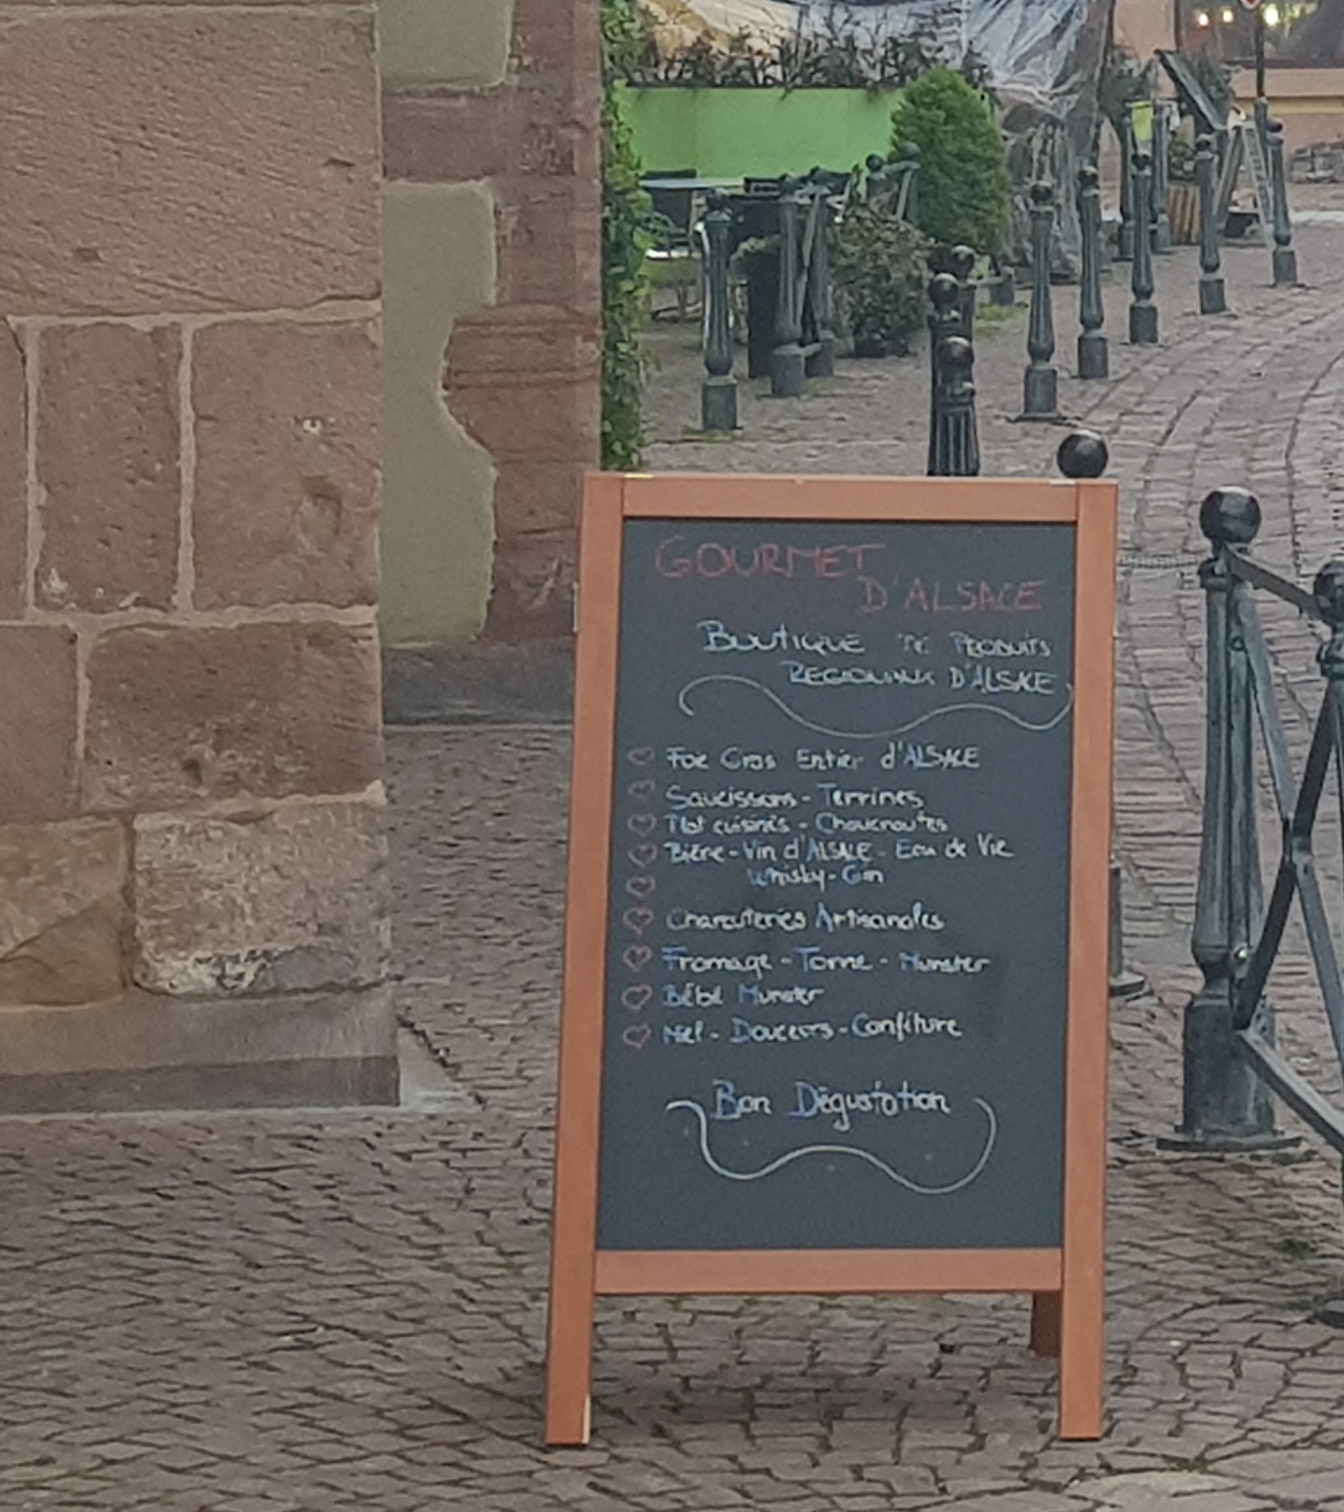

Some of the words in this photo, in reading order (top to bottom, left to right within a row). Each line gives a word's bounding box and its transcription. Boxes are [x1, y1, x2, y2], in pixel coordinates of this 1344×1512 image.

[655, 535, 886, 579] GOURMET
[857, 576, 1046, 613] D'ALSACE
[665, 746, 709, 770] Foie
[720, 746, 777, 770] Gras
[816, 783, 924, 808] Terrines
[743, 838, 777, 861] Vin
[895, 838, 936, 859] Eau
[945, 838, 966, 859] de
[977, 833, 1014, 857] Vie
[841, 863, 884, 885] Gin
[815, 901, 945, 932] Artisanales
[662, 946, 772, 980] Fromage
[899, 951, 991, 972] Munster
[738, 984, 824, 1006] Munster
[663, 1020, 703, 1045] Miel
[851, 1010, 963, 1041] Confiture
[711, 1079, 771, 1120] Bon
[787, 1080, 950, 1131] Dégustation
